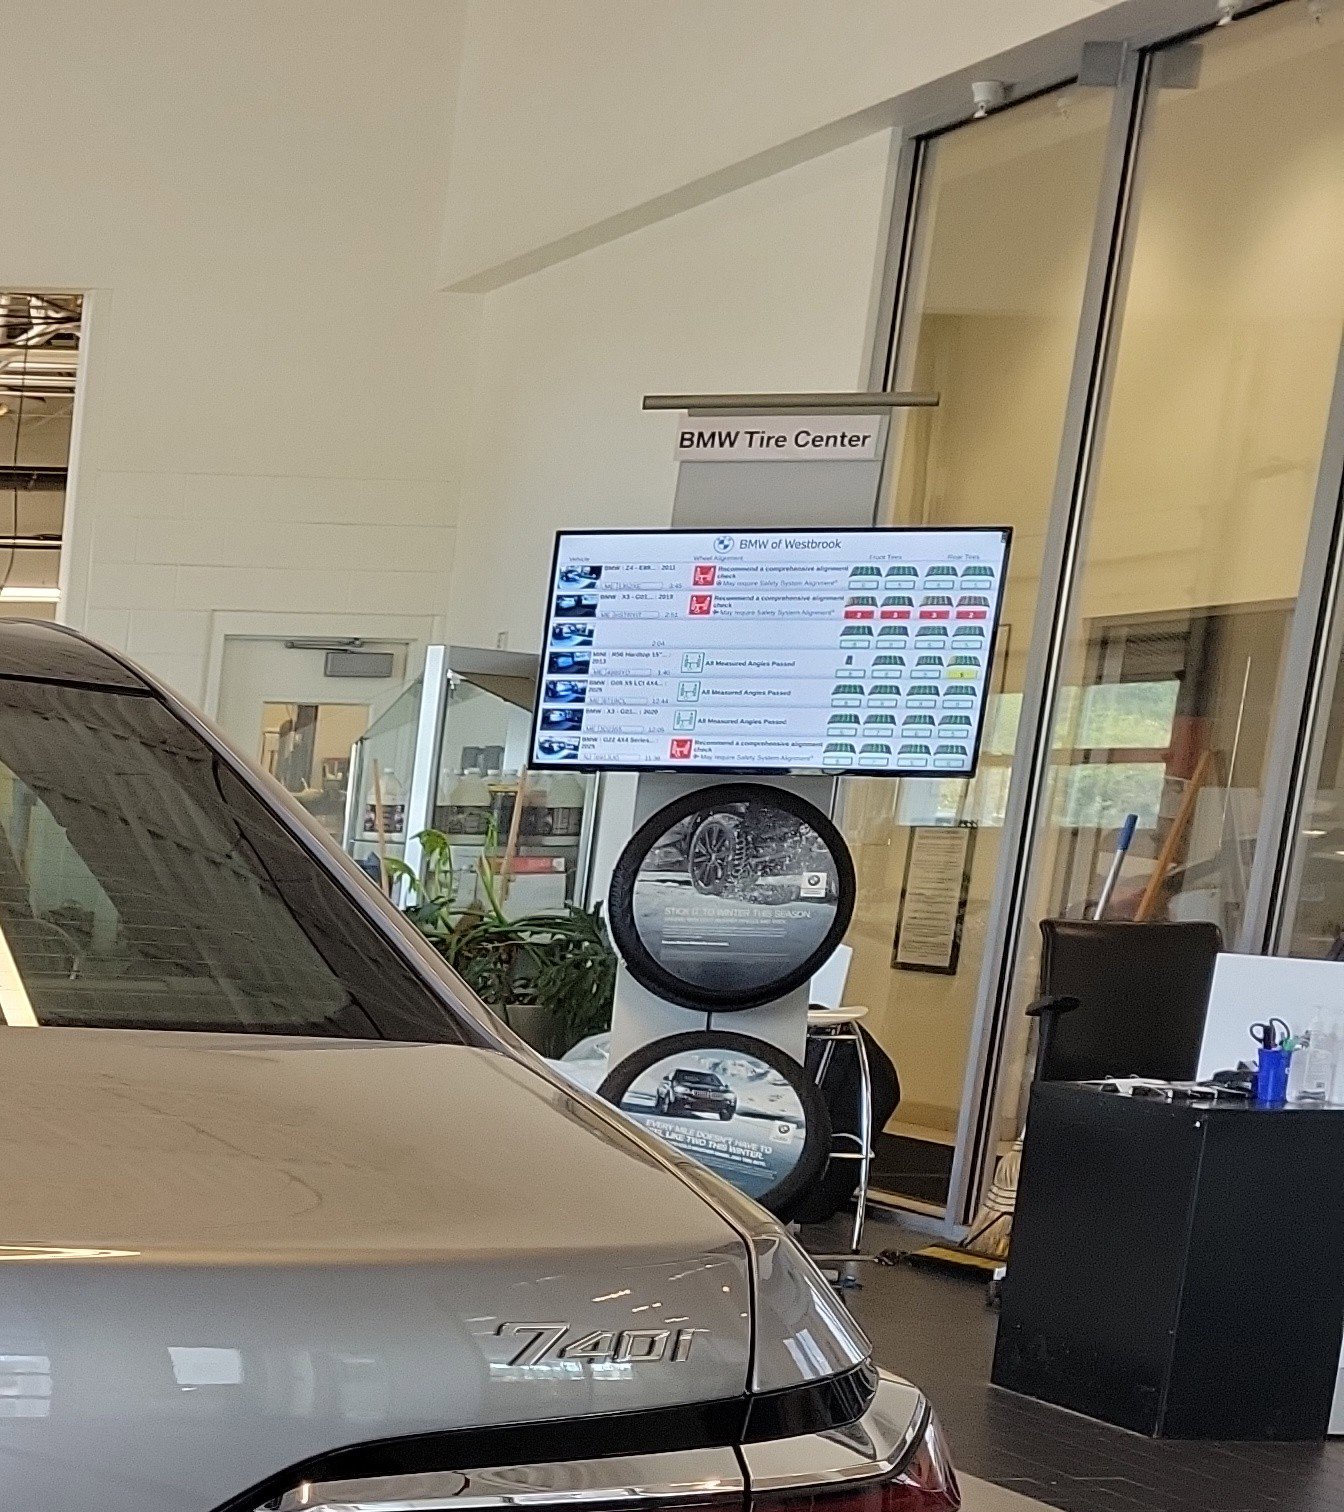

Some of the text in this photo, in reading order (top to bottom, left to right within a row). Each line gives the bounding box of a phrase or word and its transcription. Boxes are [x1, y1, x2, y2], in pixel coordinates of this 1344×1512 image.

[679, 430, 871, 448] BMW Tire Center
[739, 538, 842, 549] BMW of Westbrook
[686, 1135, 707, 1147] TWO
[760, 1145, 773, 1154] TO
